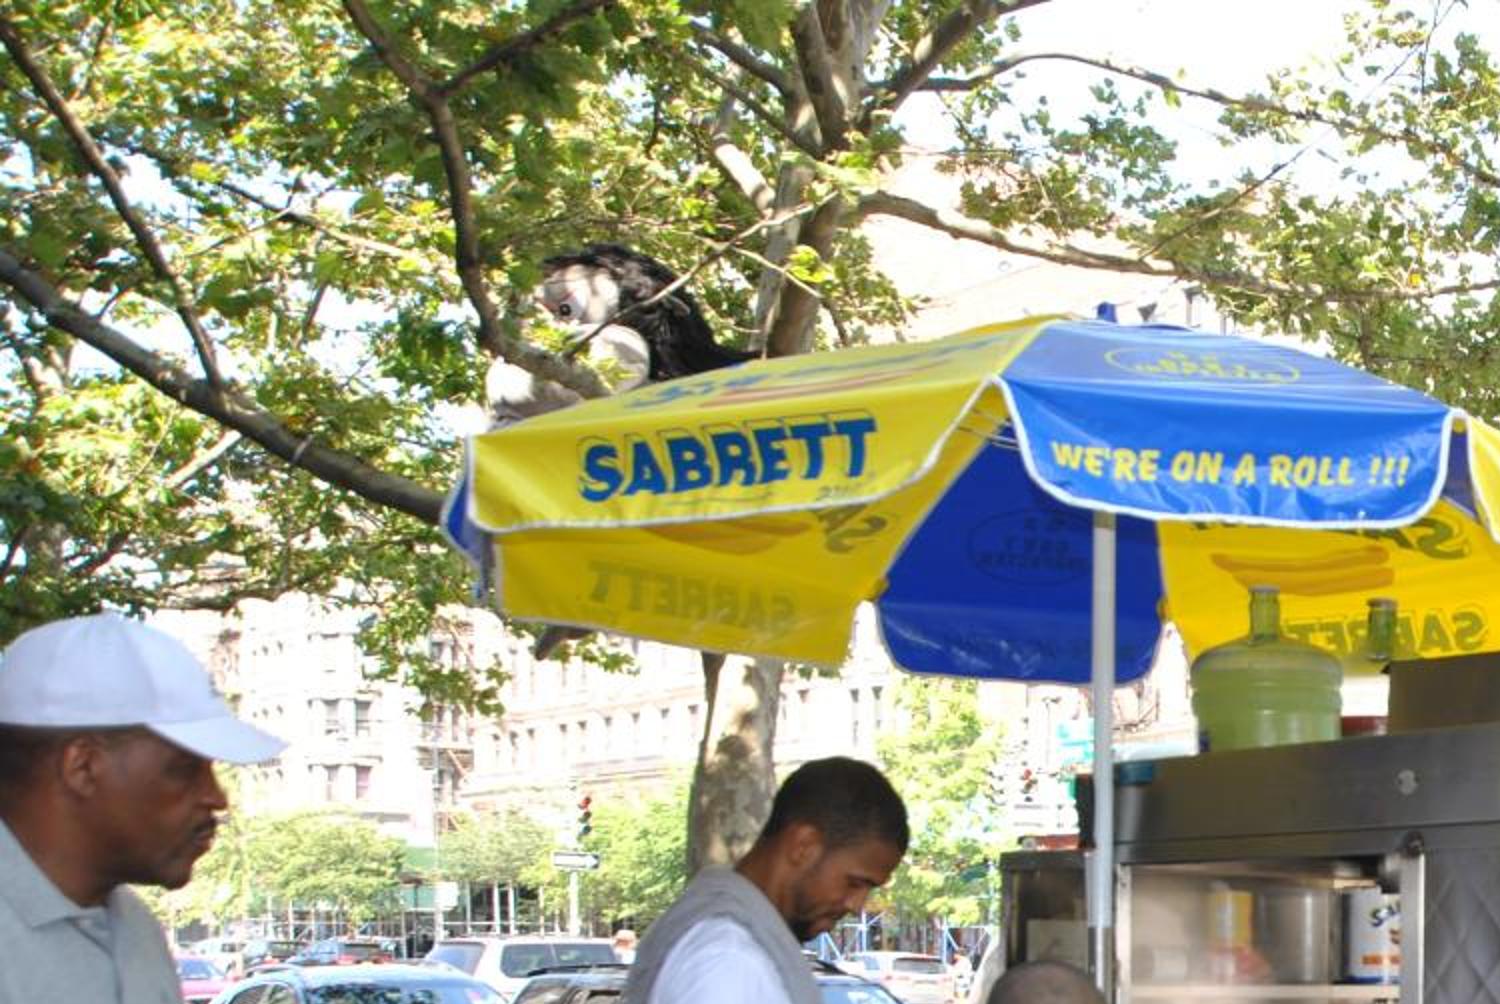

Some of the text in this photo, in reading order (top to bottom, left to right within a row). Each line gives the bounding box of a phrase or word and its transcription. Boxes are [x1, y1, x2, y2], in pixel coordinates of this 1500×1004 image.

[579, 412, 877, 502] SABRETT
[1051, 441, 1160, 482] WE'RE
[1171, 451, 1223, 484] ON
[1233, 454, 1257, 486] A
[1269, 455, 1353, 488] ROLL
